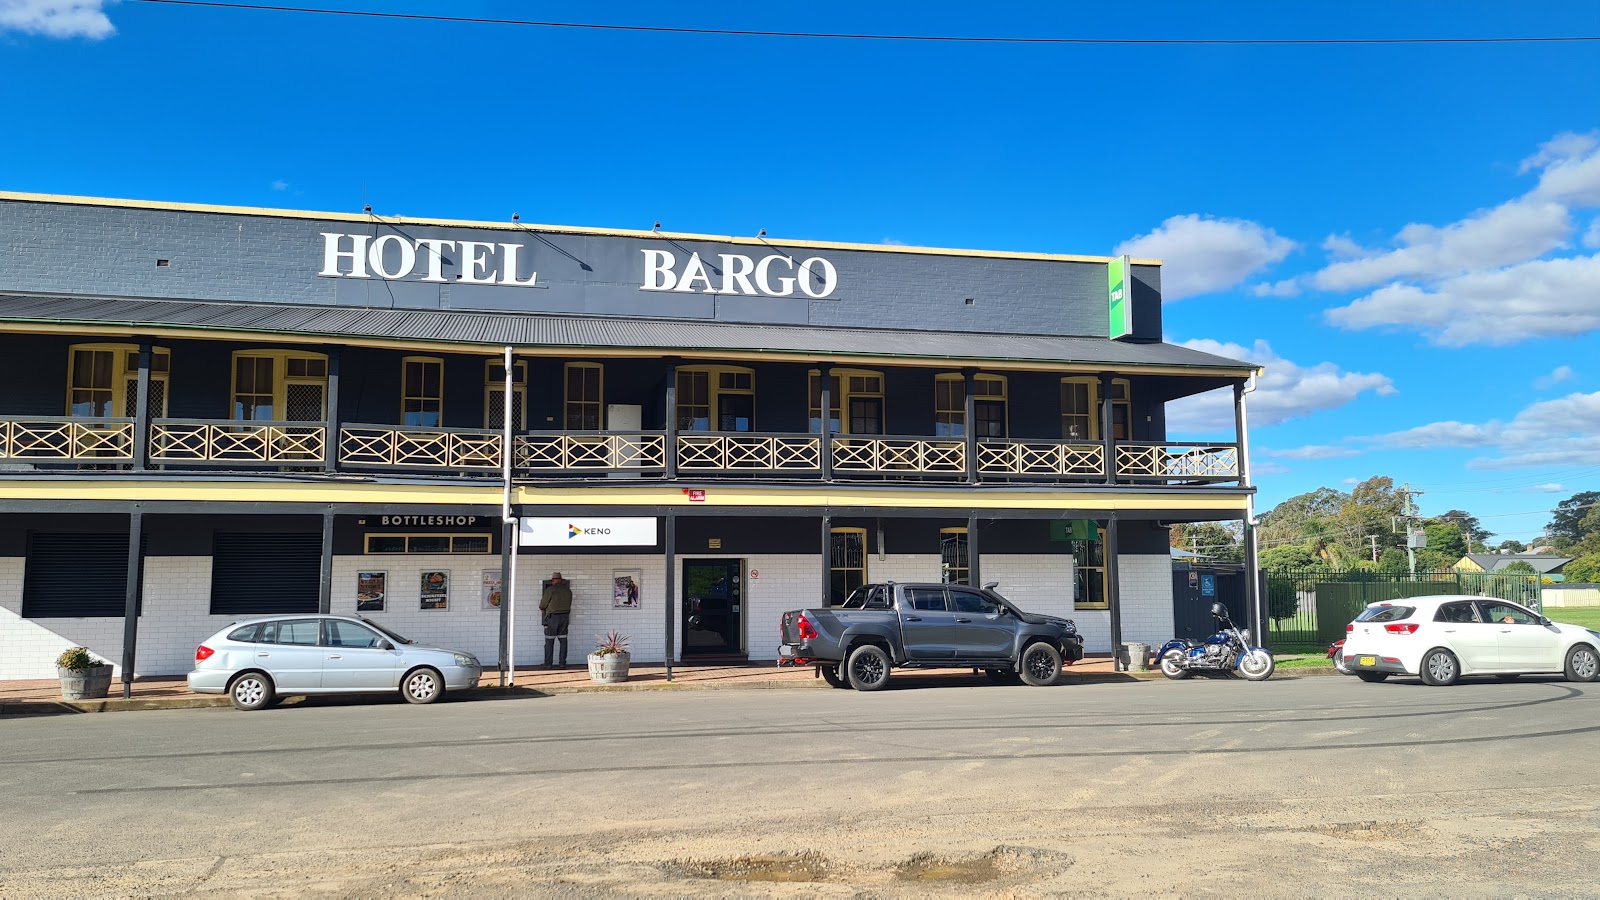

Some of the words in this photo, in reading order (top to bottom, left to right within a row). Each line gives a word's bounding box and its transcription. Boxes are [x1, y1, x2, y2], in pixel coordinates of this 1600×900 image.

[319, 232, 537, 286] HOTEL
[640, 249, 837, 298] BARGO
[1111, 289, 1122, 302] TAB
[381, 515, 476, 525] BOTTLESHOP
